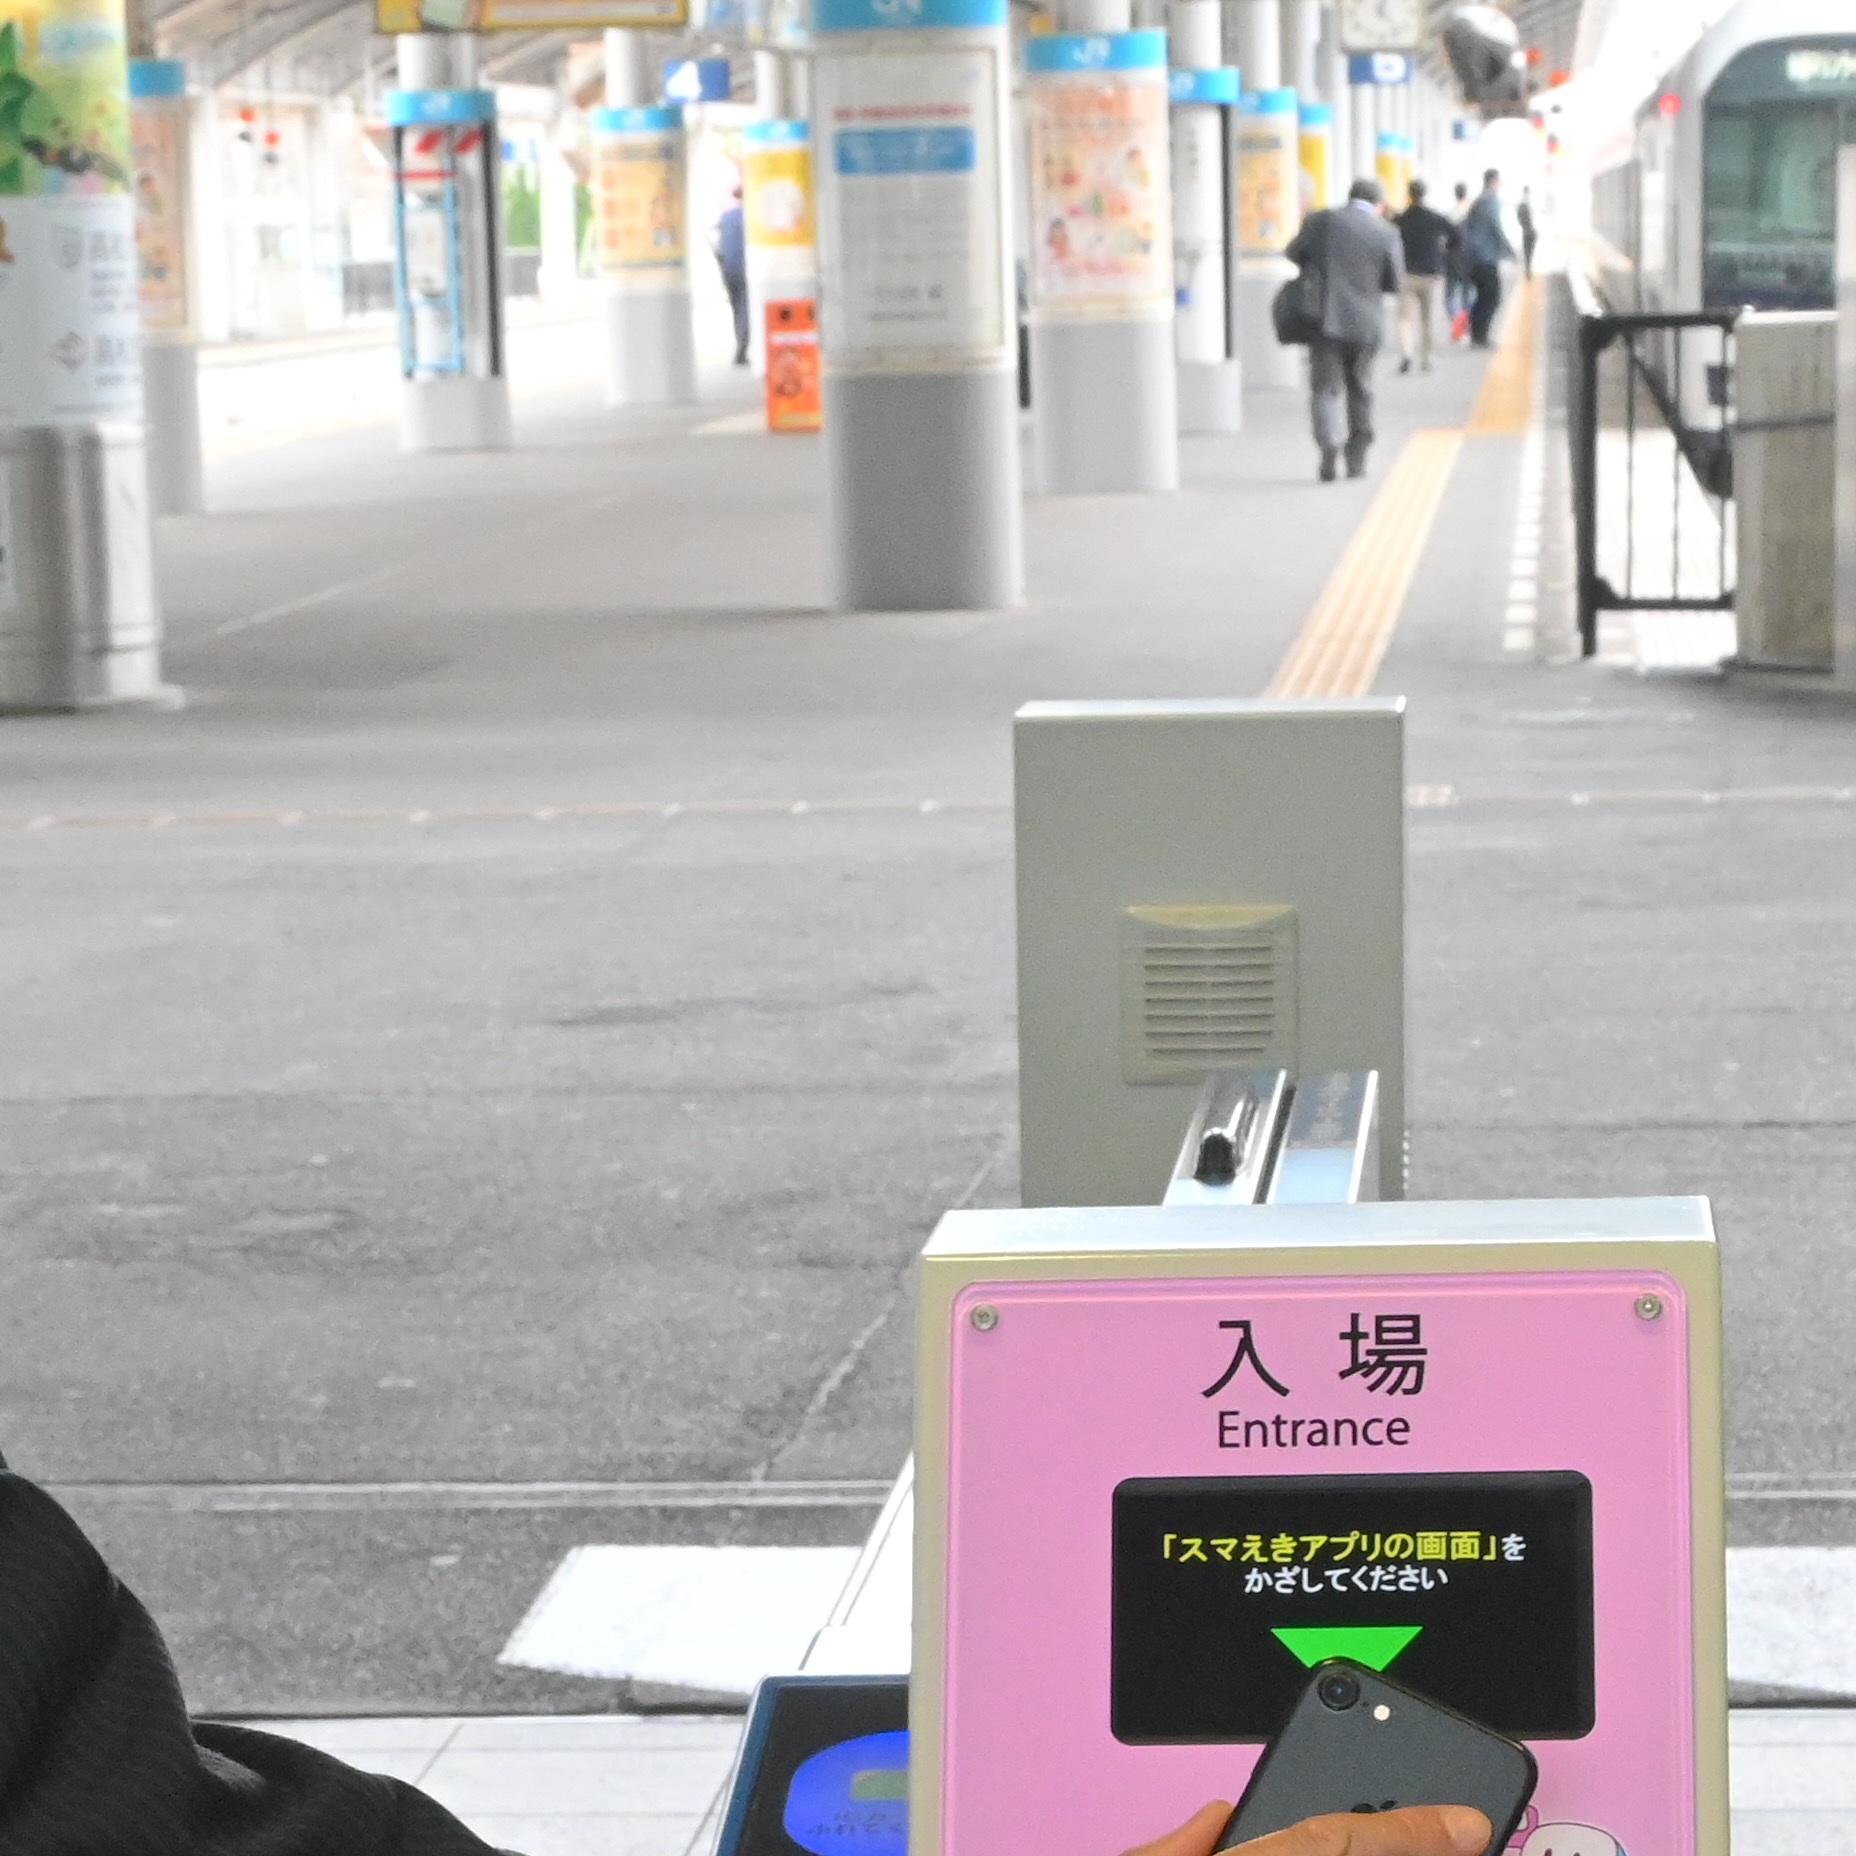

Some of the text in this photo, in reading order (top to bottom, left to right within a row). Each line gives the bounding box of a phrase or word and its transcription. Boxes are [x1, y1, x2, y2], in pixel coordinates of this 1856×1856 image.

[1201, 1312, 1429, 1399] 入場
[1217, 1410, 1412, 1449] Entrance
[1161, 1530, 1528, 1564] 「スマえきアプリの画面」を
[1243, 1565, 1449, 1594] かざしてください
